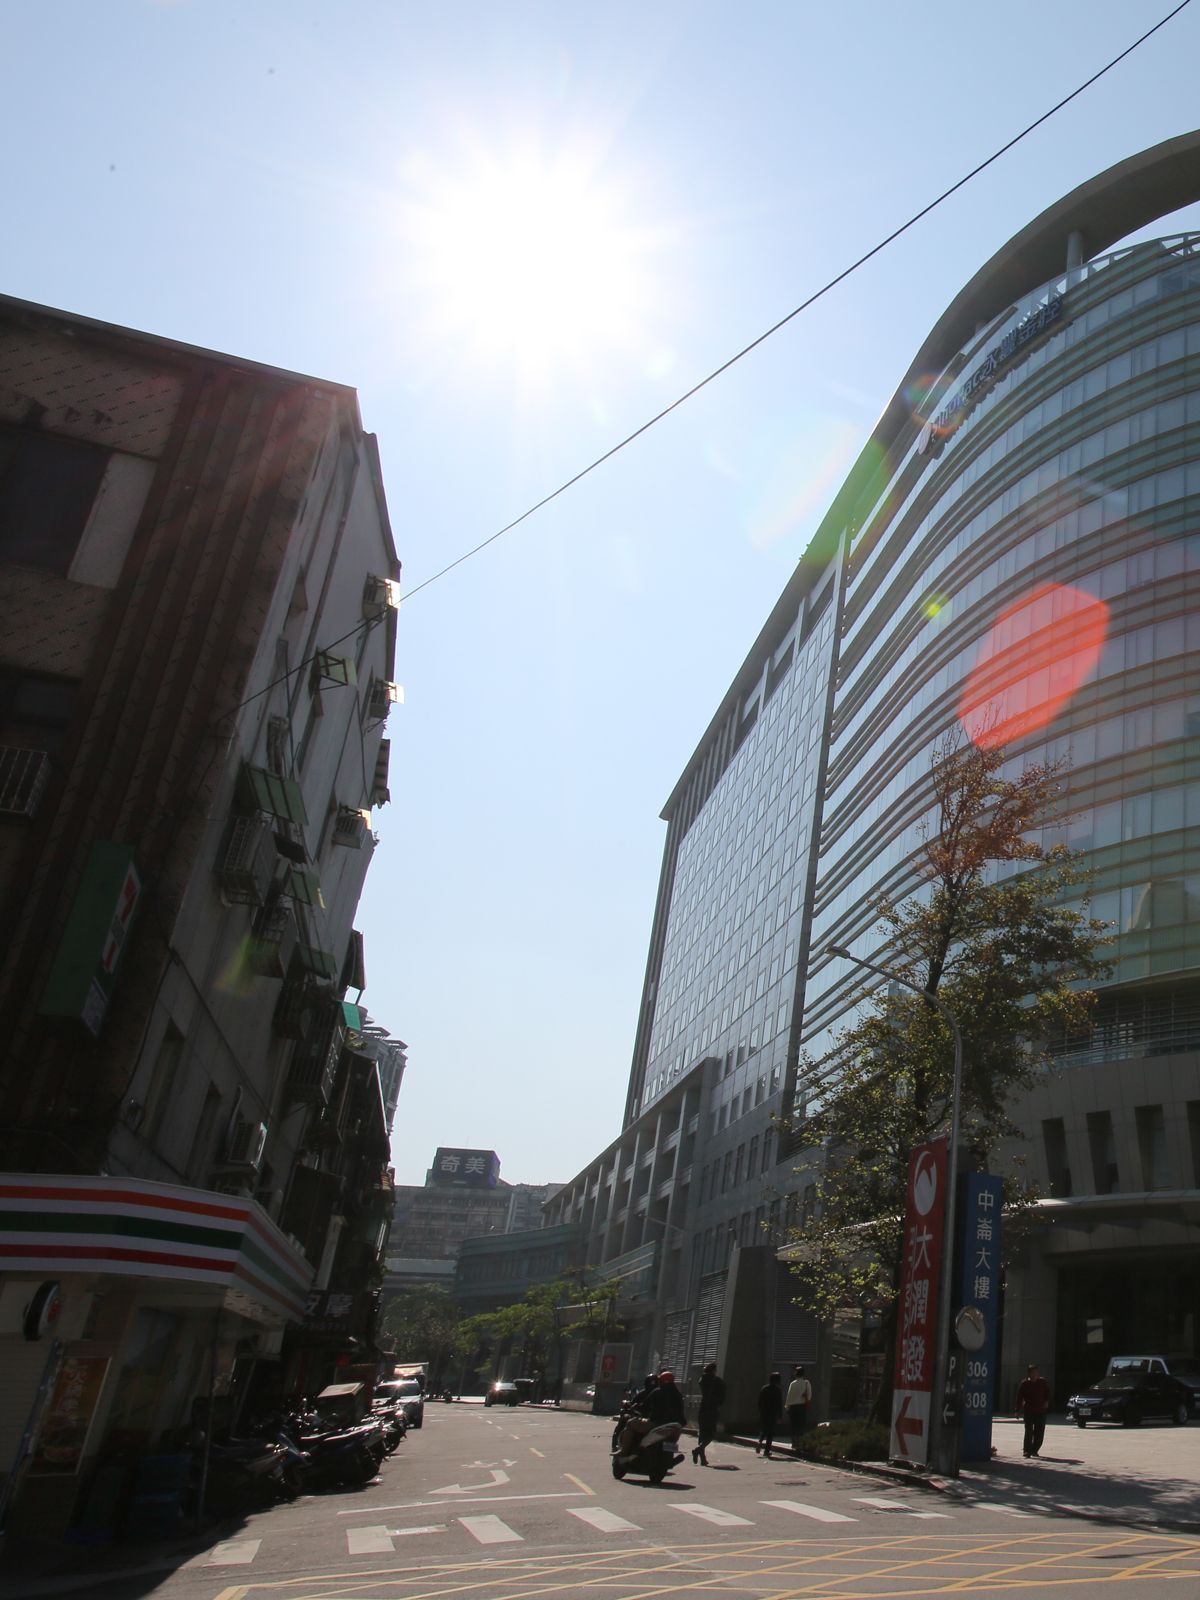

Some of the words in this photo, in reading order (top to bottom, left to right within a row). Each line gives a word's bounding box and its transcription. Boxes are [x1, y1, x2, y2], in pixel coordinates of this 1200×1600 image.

[440, 1155, 486, 1174] 奇美
[974, 1189, 994, 1299] 中崙大樓
[906, 1225, 934, 1382] 大潤發
[967, 1361, 988, 1377] 306
[965, 1392, 987, 1408] 308
